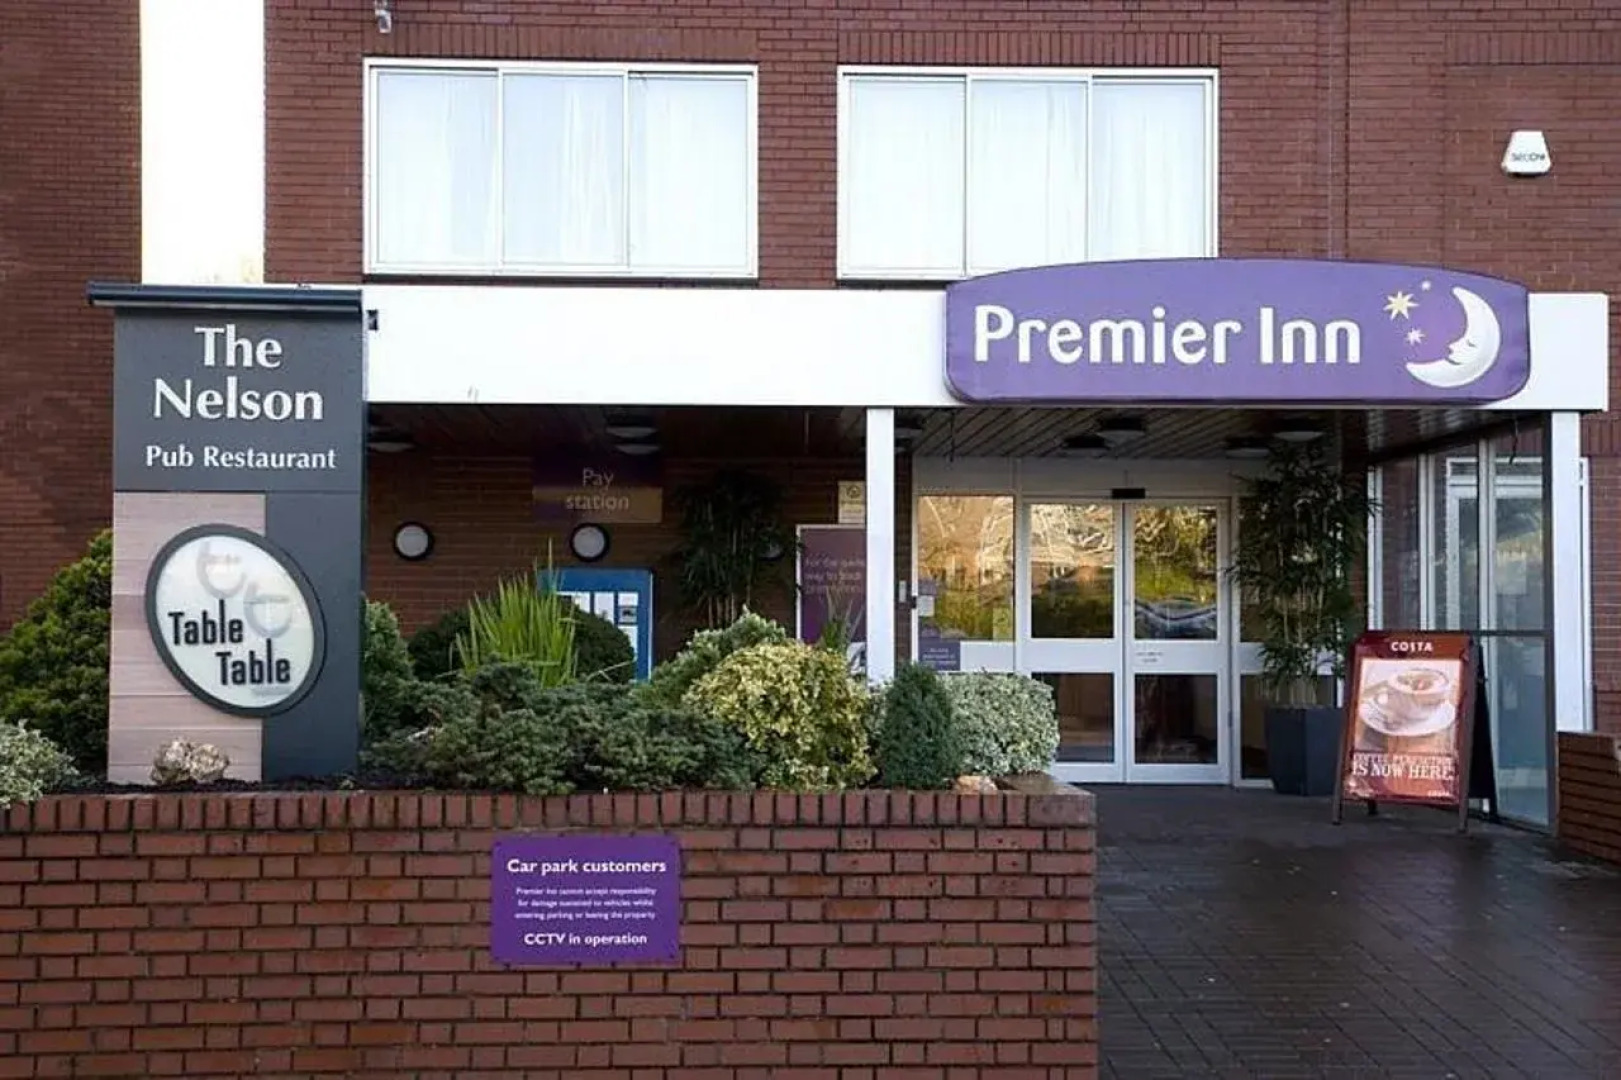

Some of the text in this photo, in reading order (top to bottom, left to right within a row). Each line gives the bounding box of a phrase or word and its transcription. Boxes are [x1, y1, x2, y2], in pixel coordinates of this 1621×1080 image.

[194, 323, 282, 368] The
[974, 304, 1361, 365] Premier Inn
[153, 375, 324, 420] Nelson
[146, 444, 337, 469] Pub Restaurant
[582, 467, 614, 491] Pay
[566, 492, 629, 510] station
[168, 599, 244, 645] Table
[1391, 641, 1433, 652] COSTA
[215, 637, 291, 686] Table
[1353, 761, 1368, 776] IS
[1370, 762, 1403, 778] NOW
[507, 859, 667, 876] Car park customers
[524, 932, 648, 947] CCTV in operation
